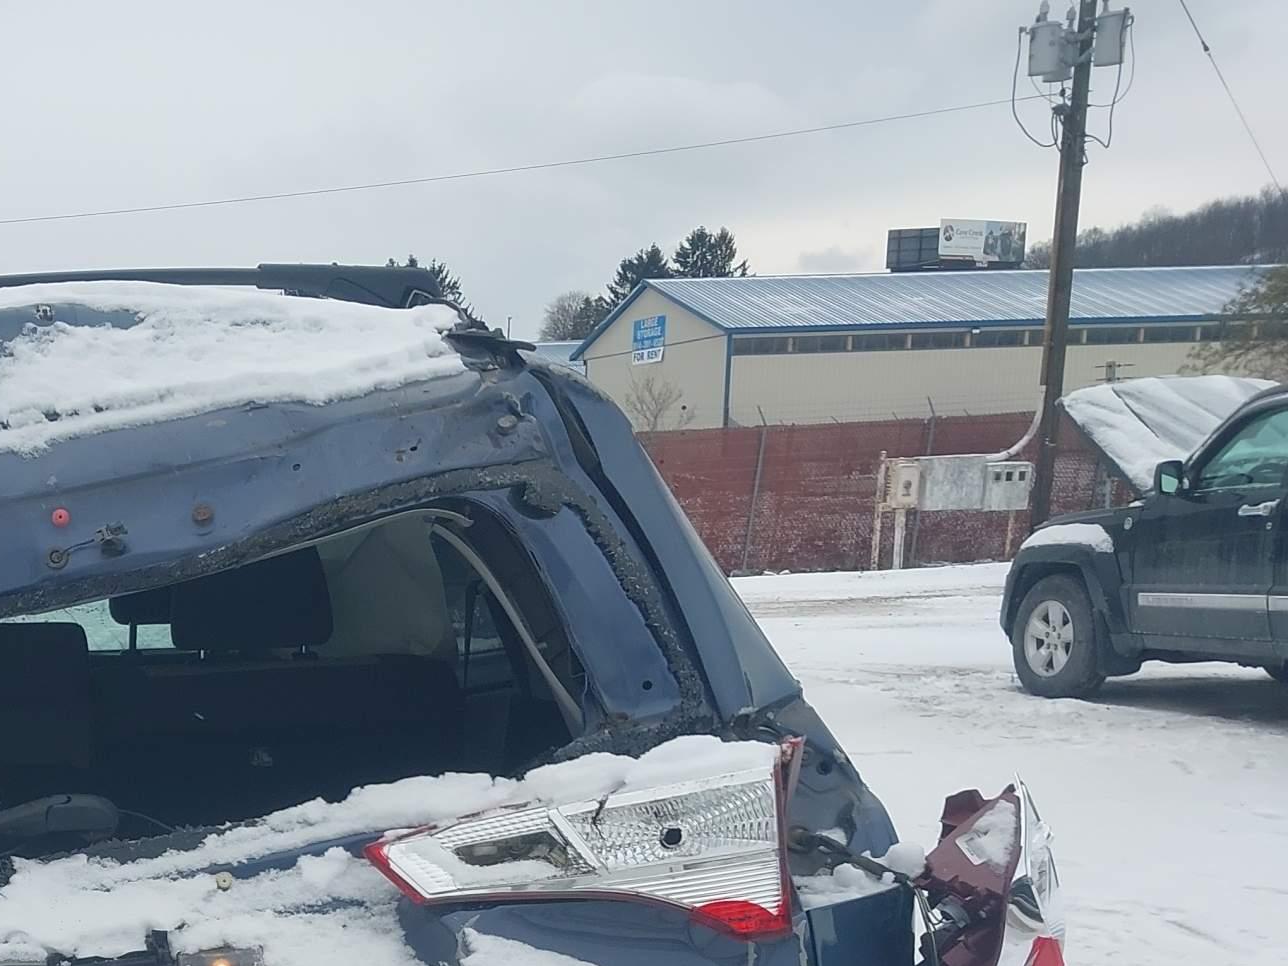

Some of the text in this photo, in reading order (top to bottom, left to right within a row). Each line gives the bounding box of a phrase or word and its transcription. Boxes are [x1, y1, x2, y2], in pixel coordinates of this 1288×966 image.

[637, 327, 662, 339] STORAGE
[633, 350, 661, 362] FOR RENT
